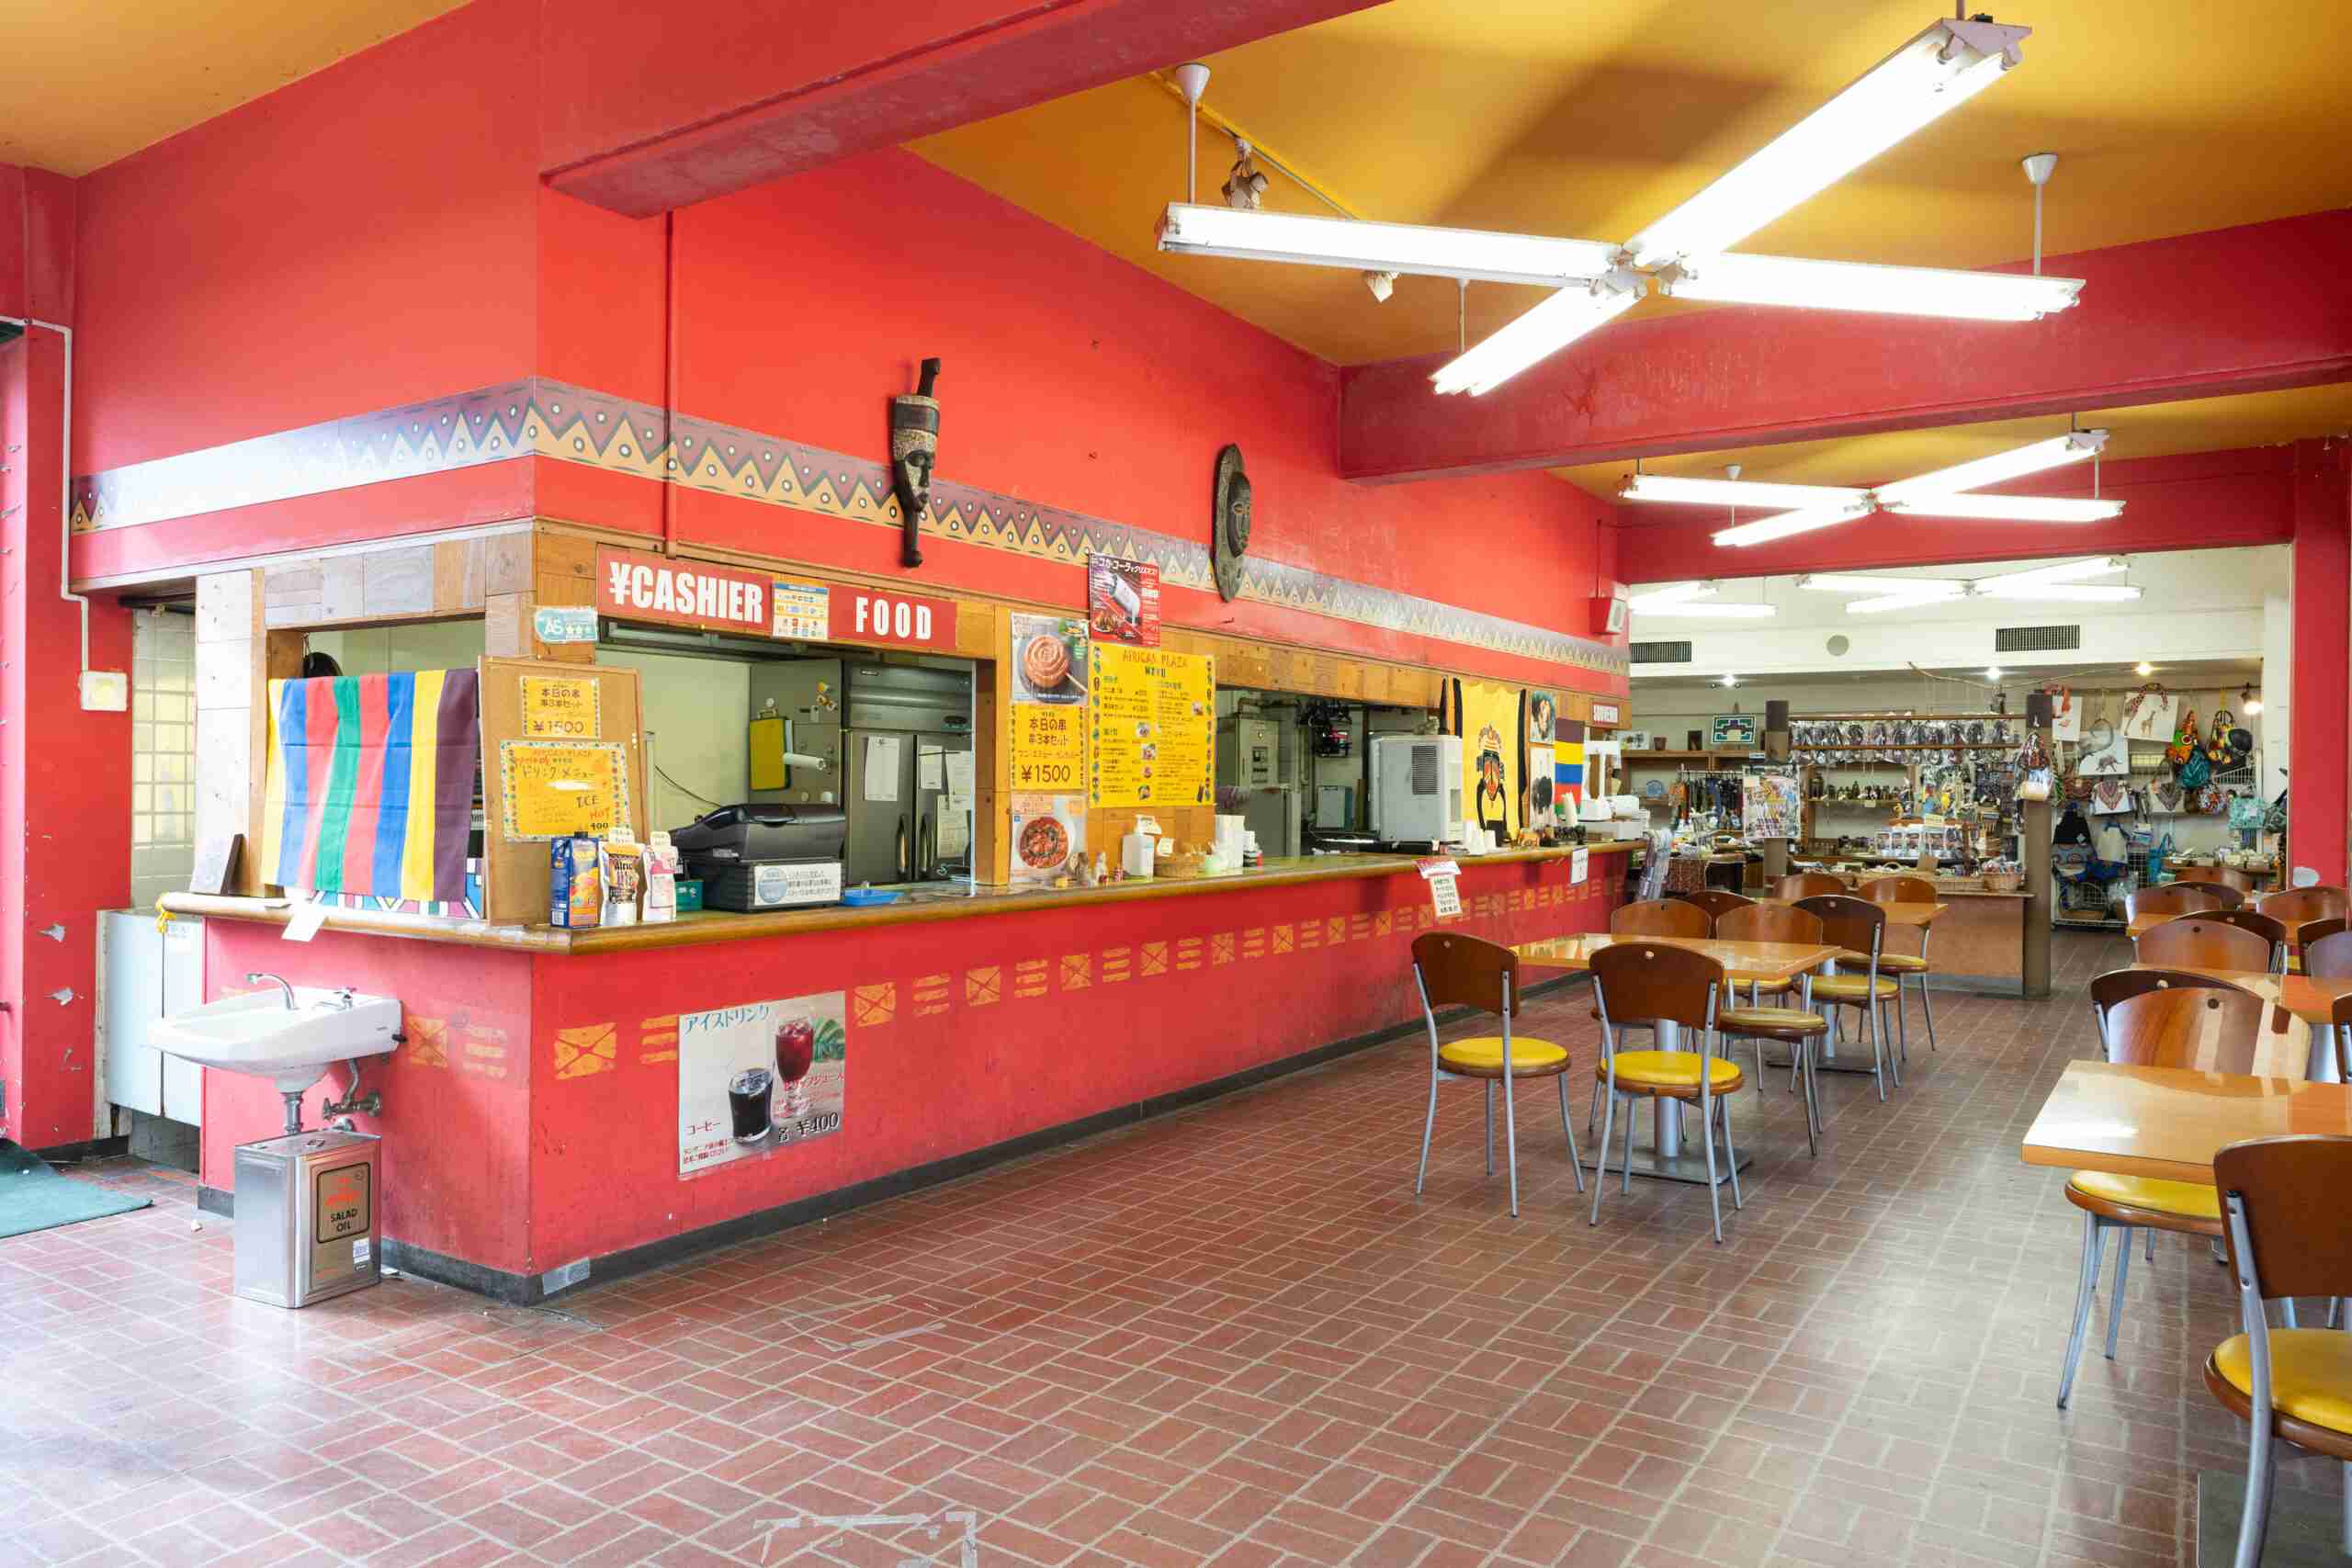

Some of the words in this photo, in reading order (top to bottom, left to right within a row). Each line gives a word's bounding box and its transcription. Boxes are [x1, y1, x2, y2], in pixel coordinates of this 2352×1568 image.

[855, 596, 933, 640] FOOD
[1021, 764, 1071, 783] ¥1500
[330, 1208, 358, 1224] SALAD
[336, 1222, 352, 1233] OIL
